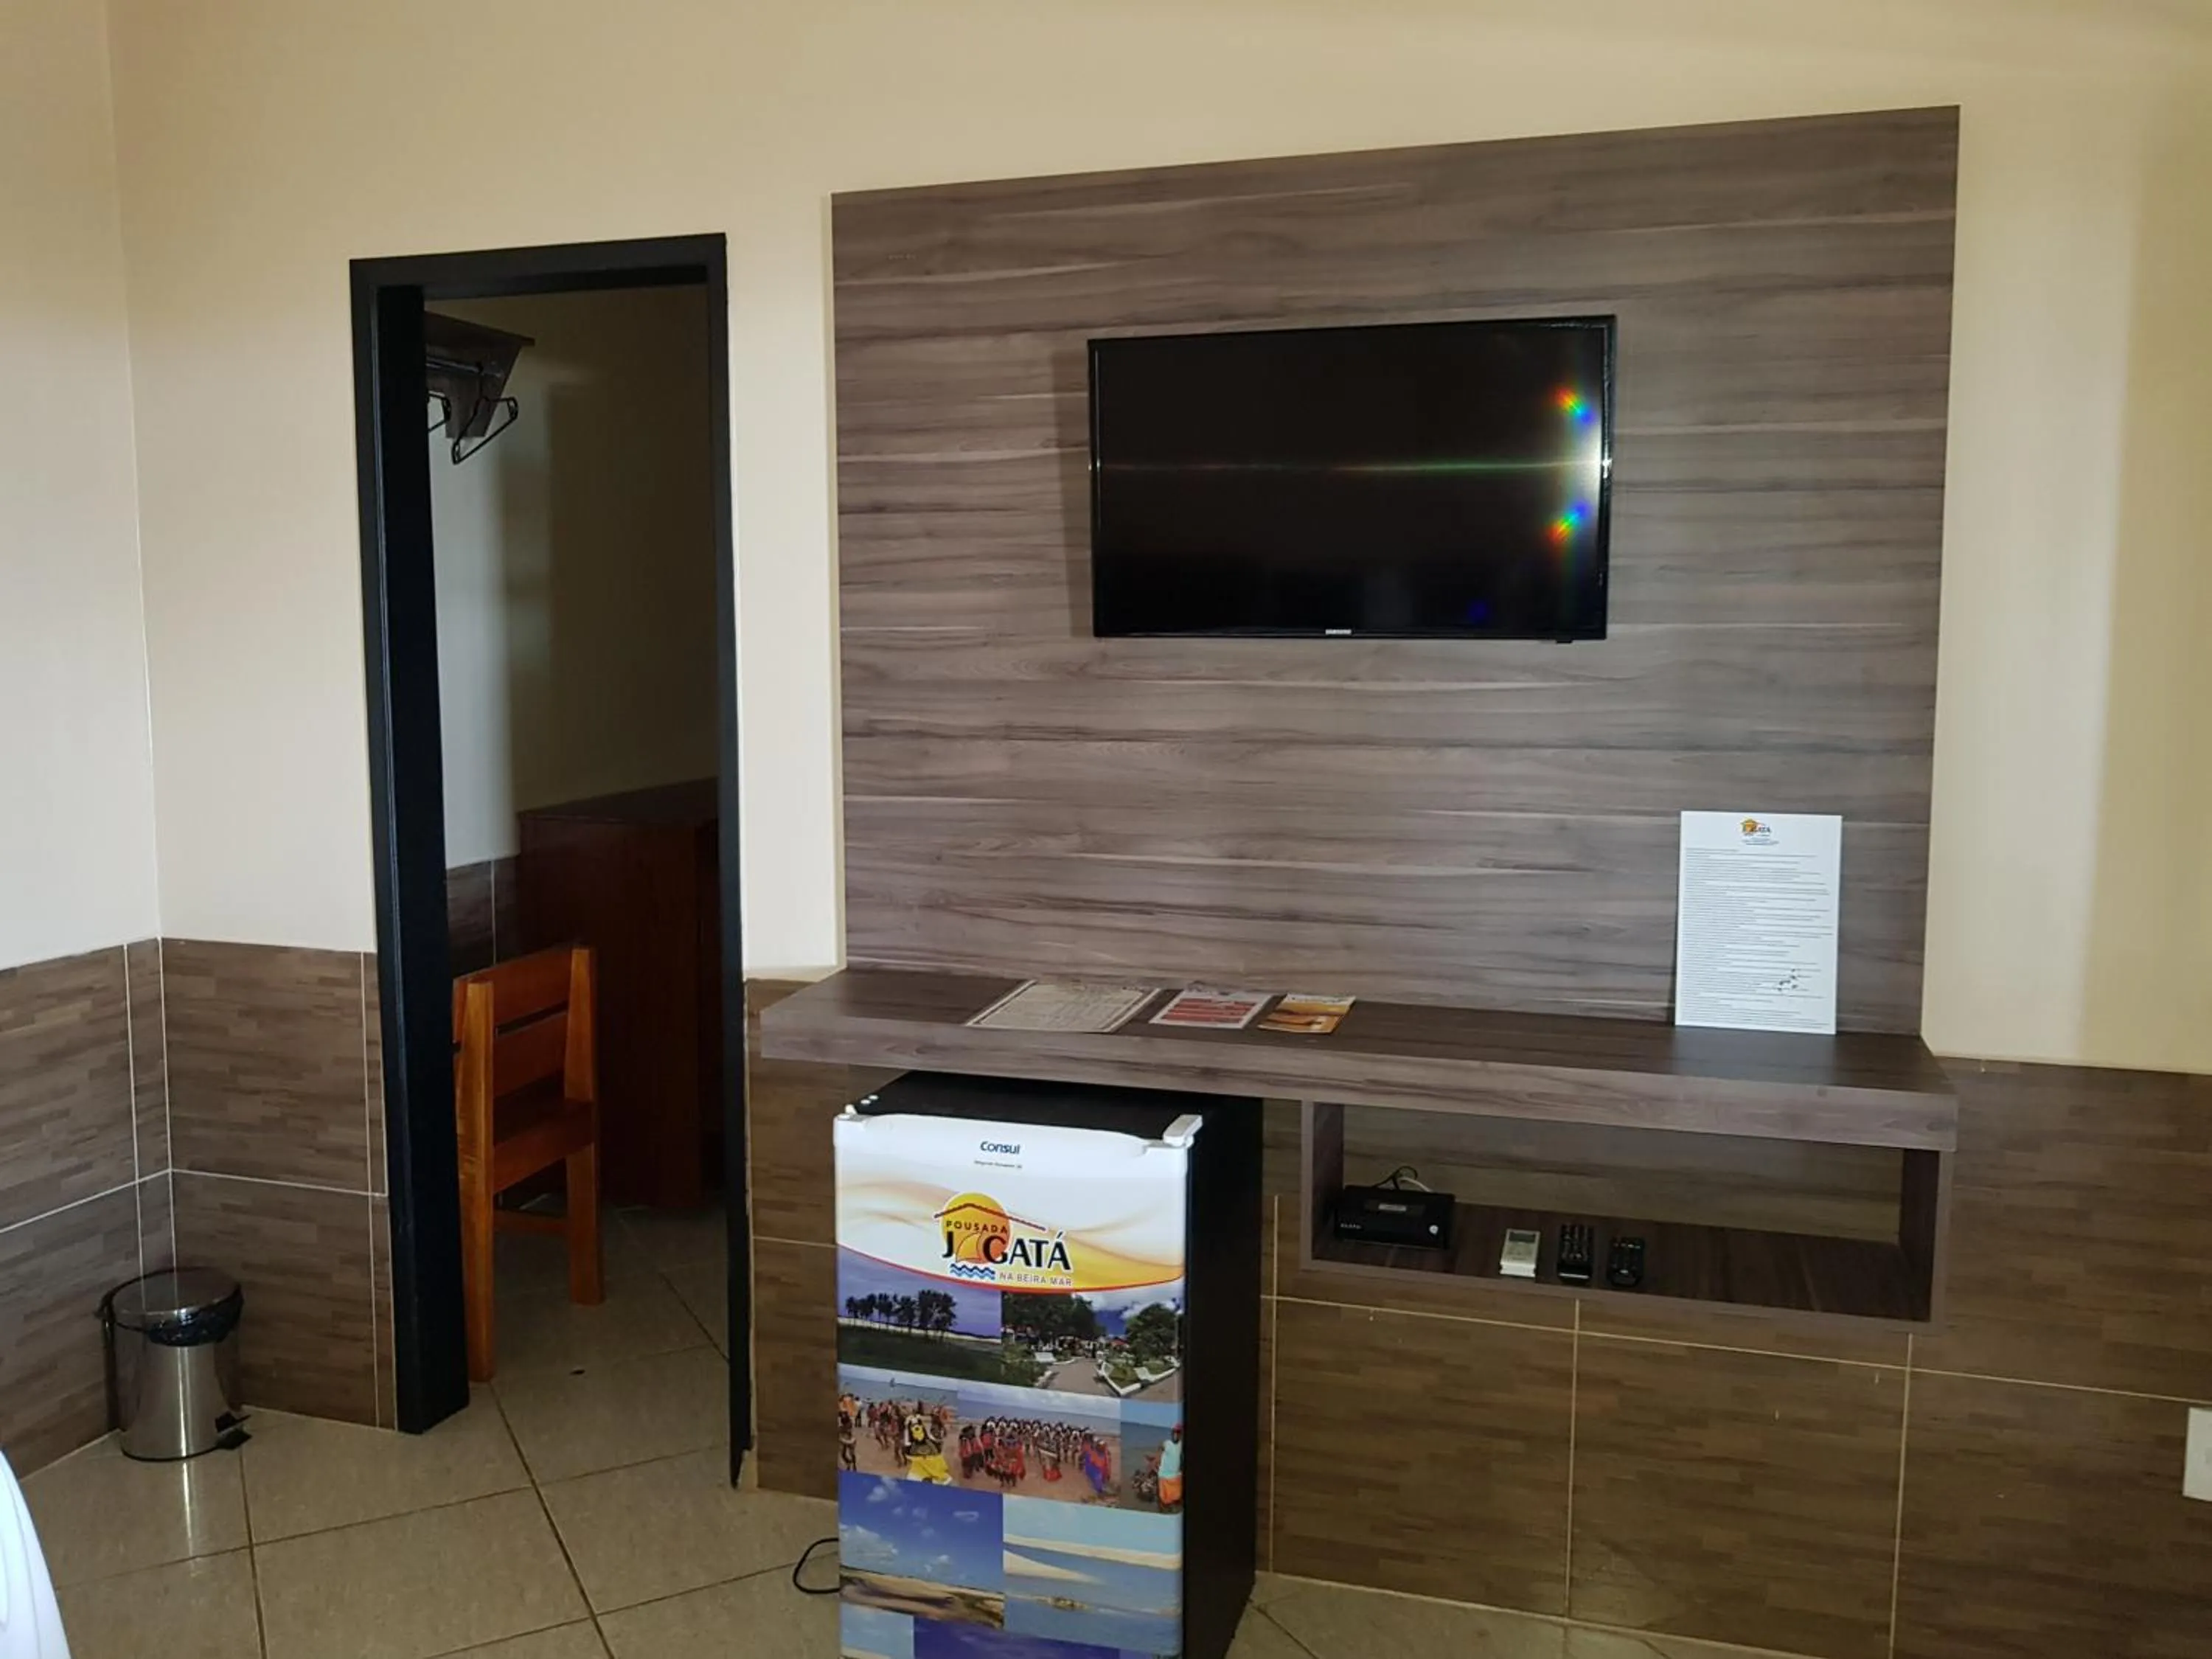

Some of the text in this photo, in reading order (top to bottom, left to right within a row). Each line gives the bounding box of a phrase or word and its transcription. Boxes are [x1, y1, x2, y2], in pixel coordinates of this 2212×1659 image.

[980, 1141, 1020, 1155] Consul
[946, 1220, 1008, 1234] POUSADA
[999, 1272, 1071, 1286] NA BEIRA MAR
